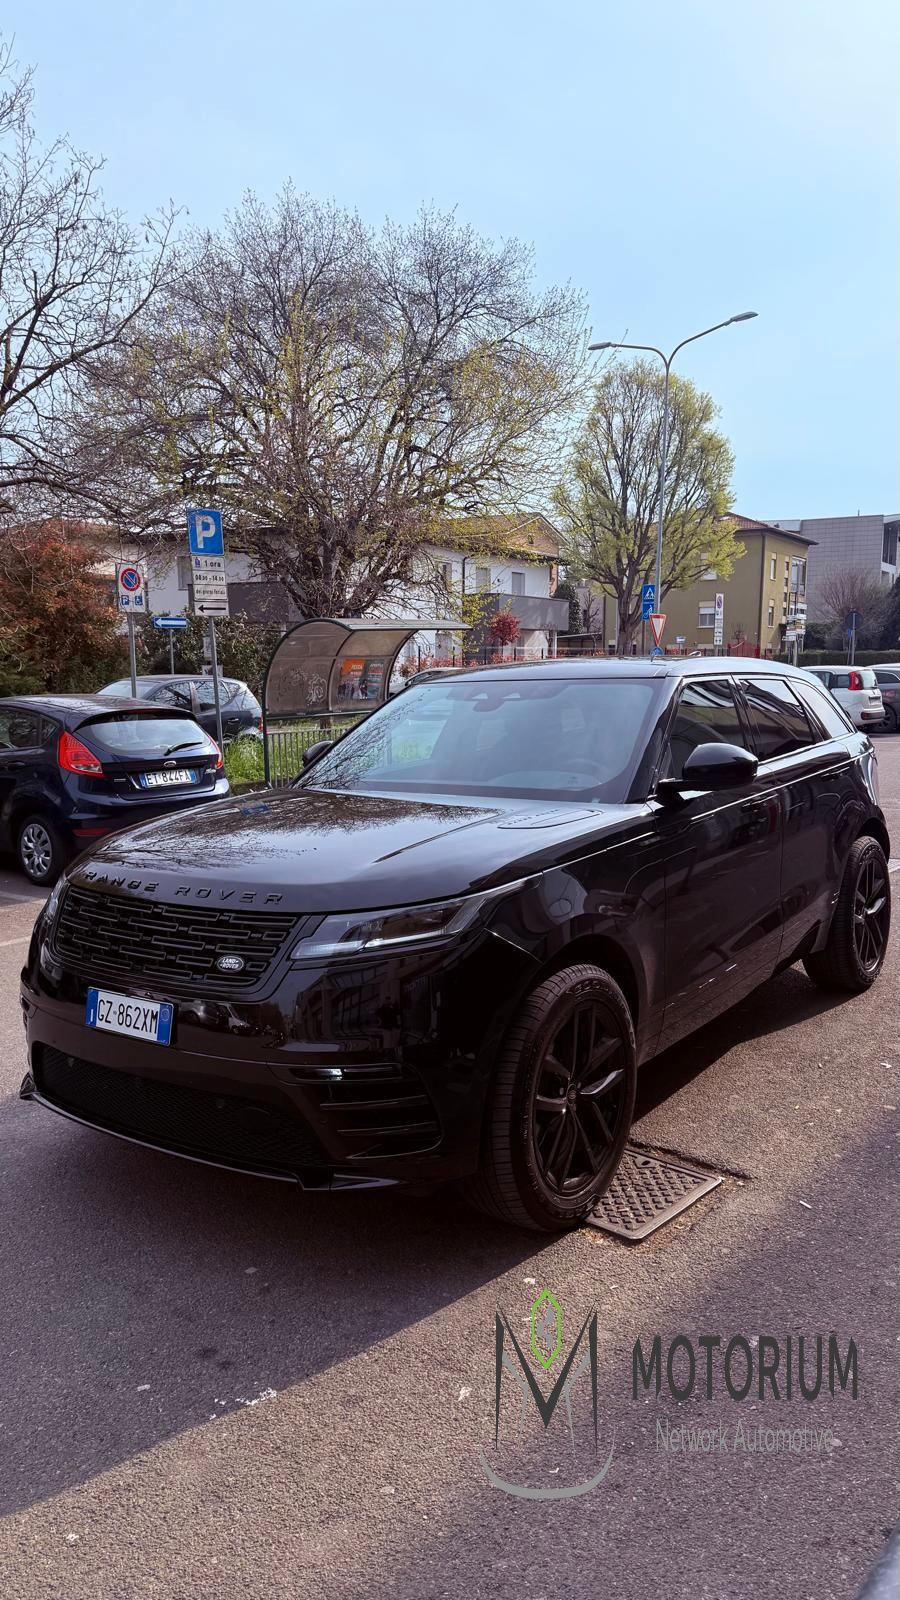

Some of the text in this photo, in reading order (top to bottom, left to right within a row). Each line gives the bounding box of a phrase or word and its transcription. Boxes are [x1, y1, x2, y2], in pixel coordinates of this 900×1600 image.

[195, 514, 216, 549] P
[146, 772, 158, 784] ET
[85, 871, 284, 906] RANGE ROVER
[97, 998, 159, 1034] GZ 862XM
